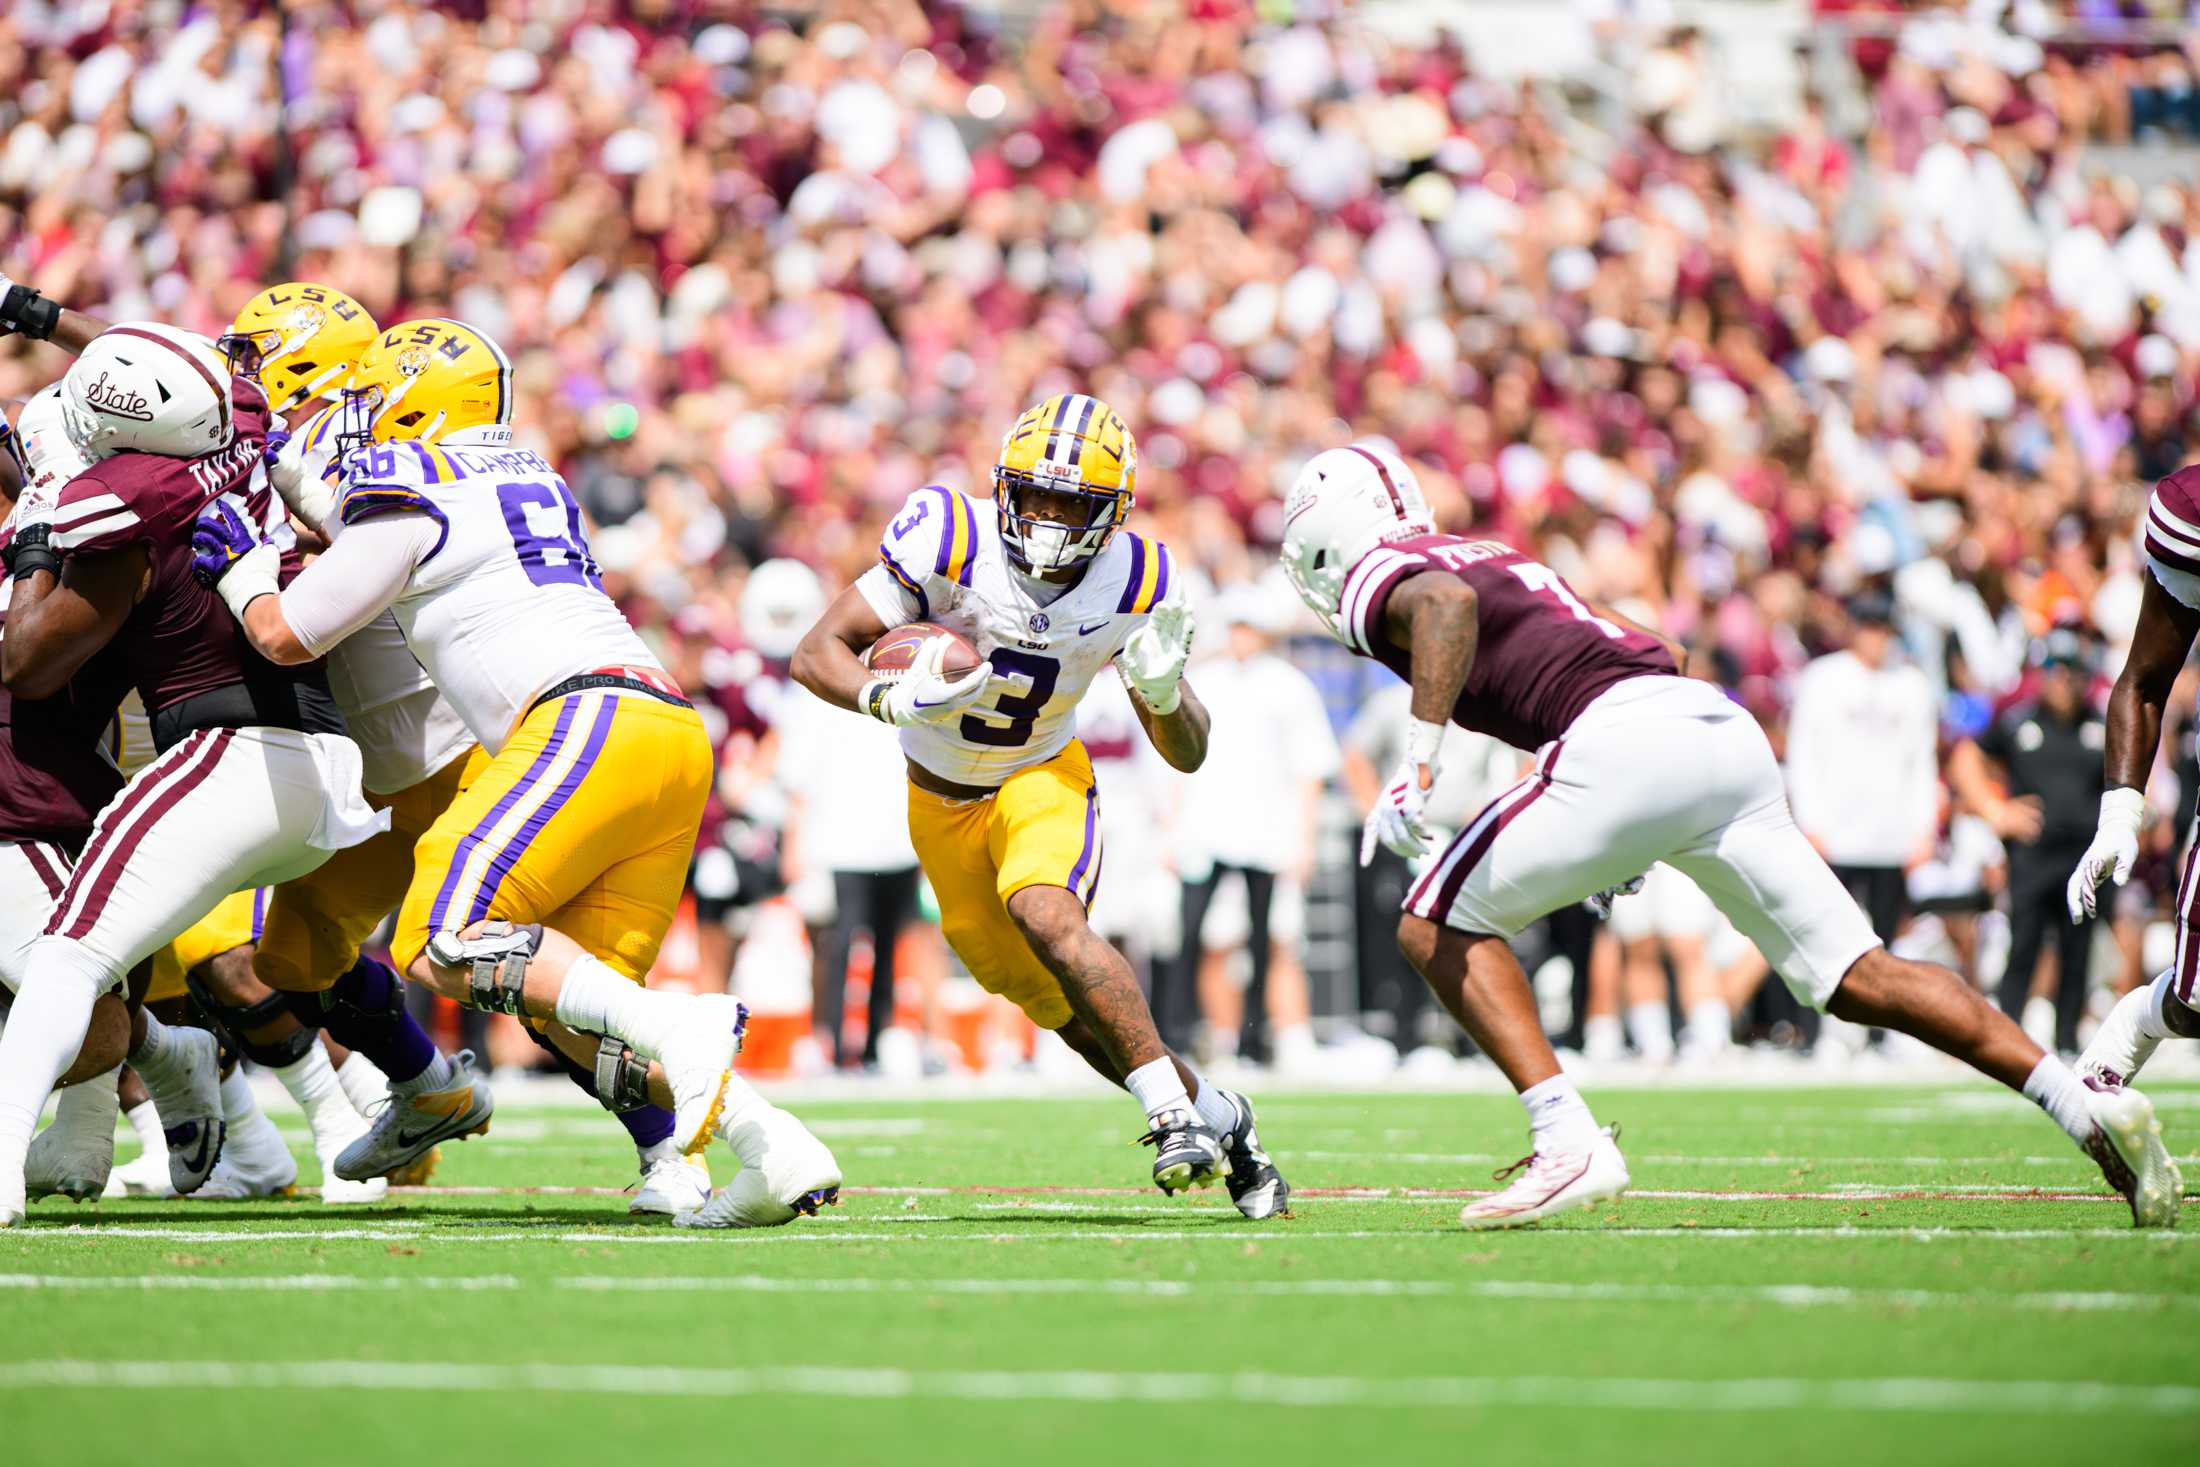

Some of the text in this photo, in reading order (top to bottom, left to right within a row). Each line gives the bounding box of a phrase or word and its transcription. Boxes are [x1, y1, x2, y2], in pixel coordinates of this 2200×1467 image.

[87, 371, 153, 421] State
[188, 439, 261, 496] TAYLOR
[1046, 464, 1071, 477] LSU
[892, 500, 929, 541] 3
[1506, 562, 1626, 639] 7
[1017, 639, 1049, 651] LSU
[582, 675, 615, 688] PRO
[959, 647, 1061, 747] 3
